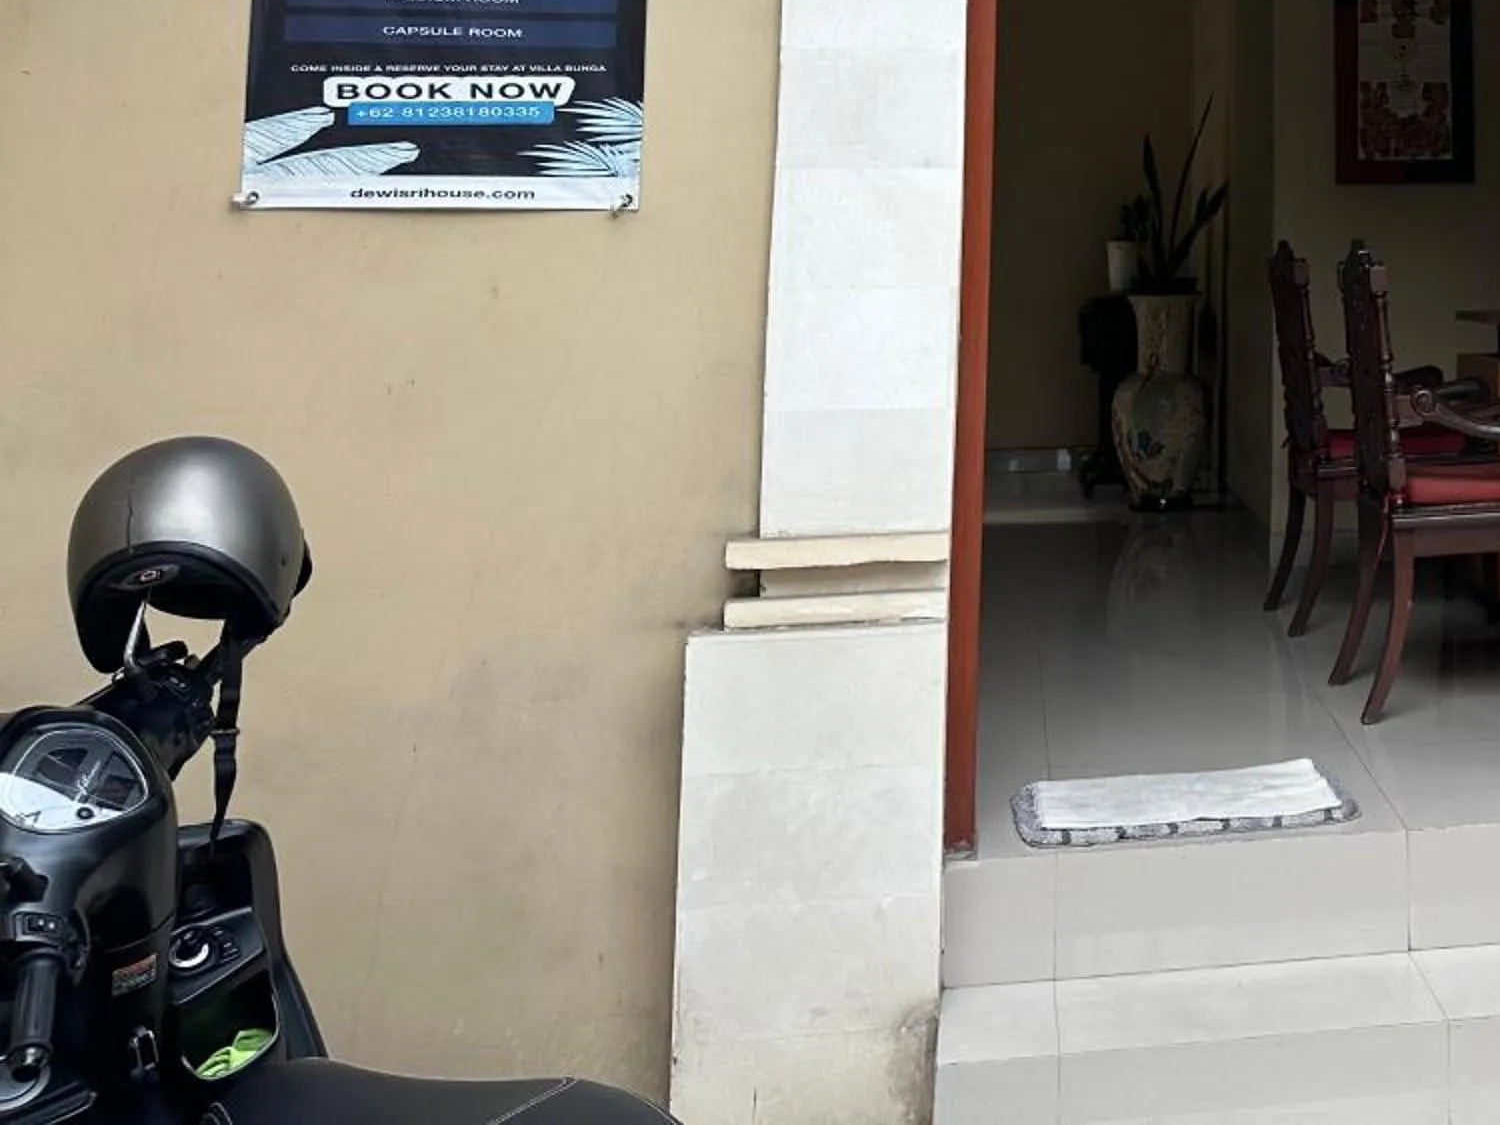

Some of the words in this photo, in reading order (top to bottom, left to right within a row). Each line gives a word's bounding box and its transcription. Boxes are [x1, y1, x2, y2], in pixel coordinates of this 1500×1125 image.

[383, 25, 463, 36] CAPSULE
[469, 27, 523, 38] ROOM
[291, 64, 327, 72] COME
[331, 64, 371, 72] INSIDE
[386, 64, 440, 72] RESERVE
[444, 64, 477, 72] YOUR
[481, 64, 509, 72] STAY
[512, 64, 526, 72] AT
[529, 64, 561, 72] VILLA
[565, 64, 607, 72] BUNGA
[336, 82, 451, 100] BOOK
[470, 82, 563, 100] NOW
[356, 106, 393, 118] +62
[401, 106, 542, 118] 81238180335
[350, 187, 536, 200] dewisrihouse.com
